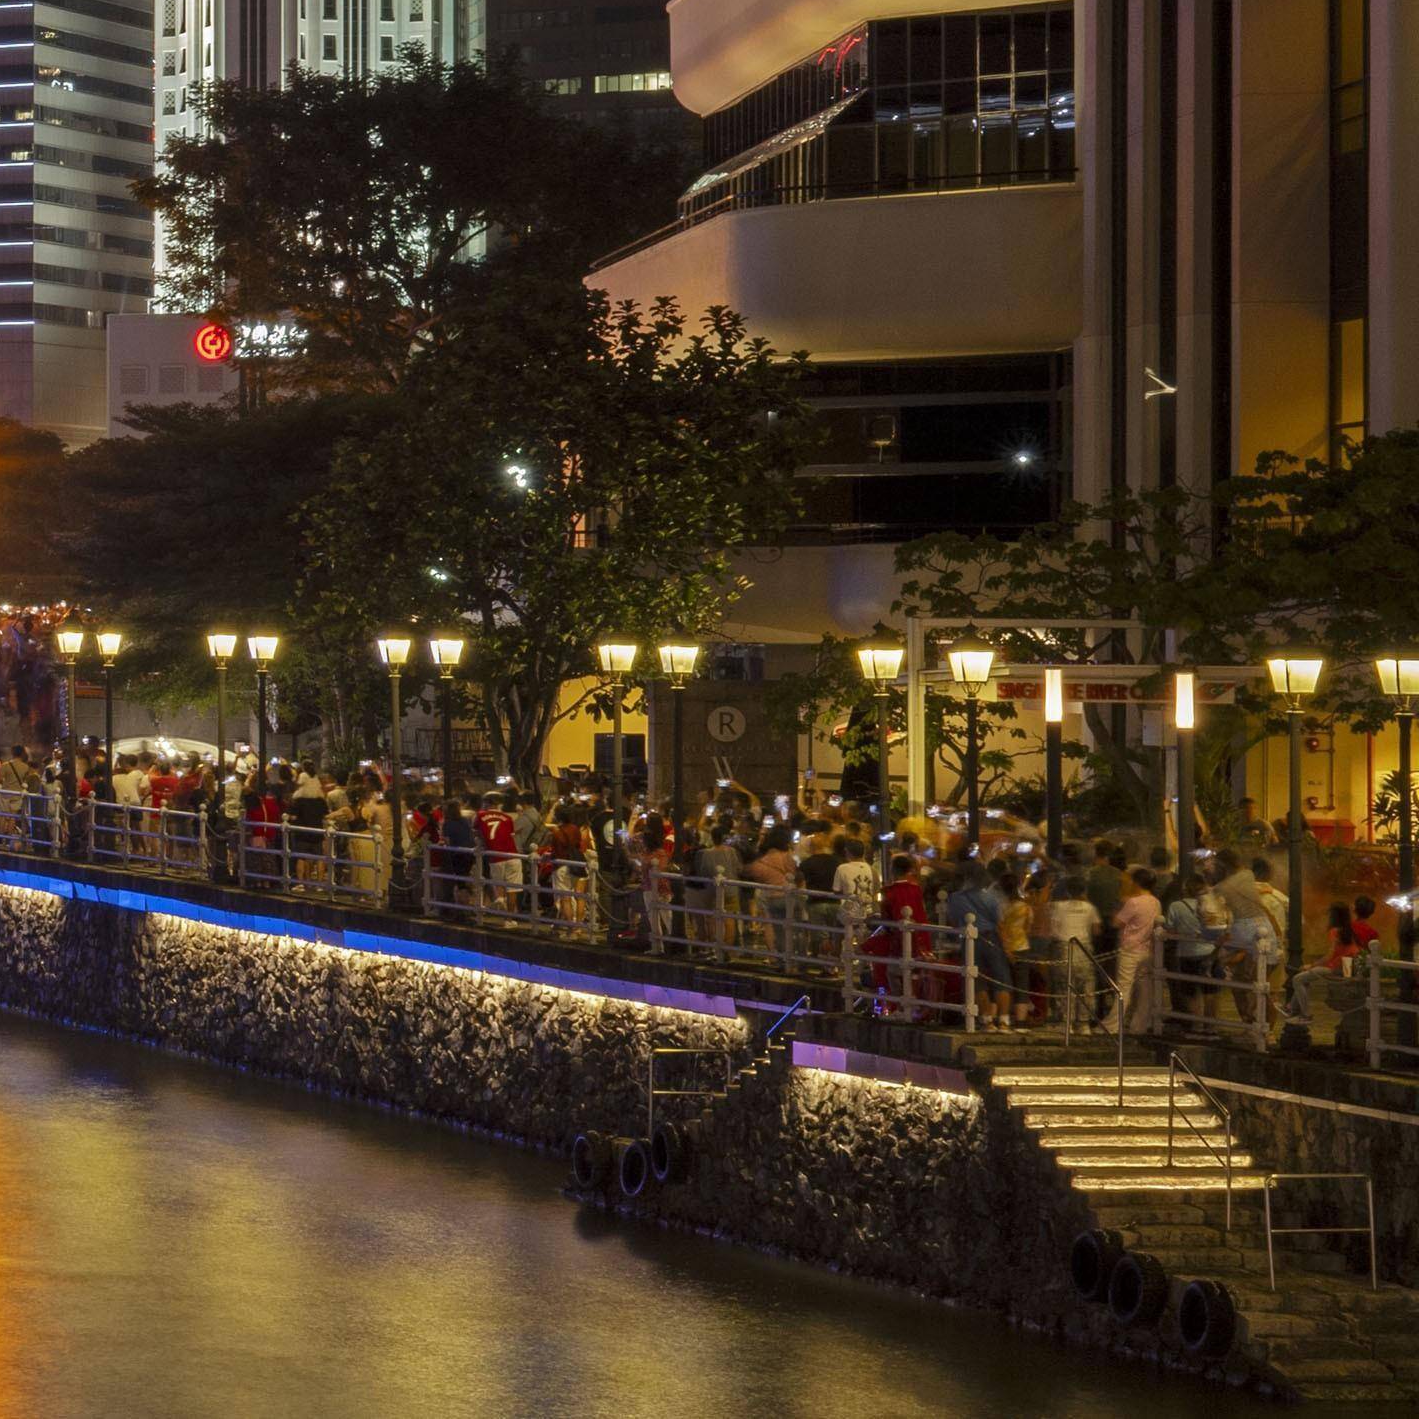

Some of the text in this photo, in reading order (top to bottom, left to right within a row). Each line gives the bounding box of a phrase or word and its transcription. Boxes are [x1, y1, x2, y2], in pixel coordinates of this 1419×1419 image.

[997, 682, 1084, 699] SINGARE
[1086, 683, 1127, 700] RIVER
[719, 712, 737, 736] R
[487, 821, 500, 840] 7
